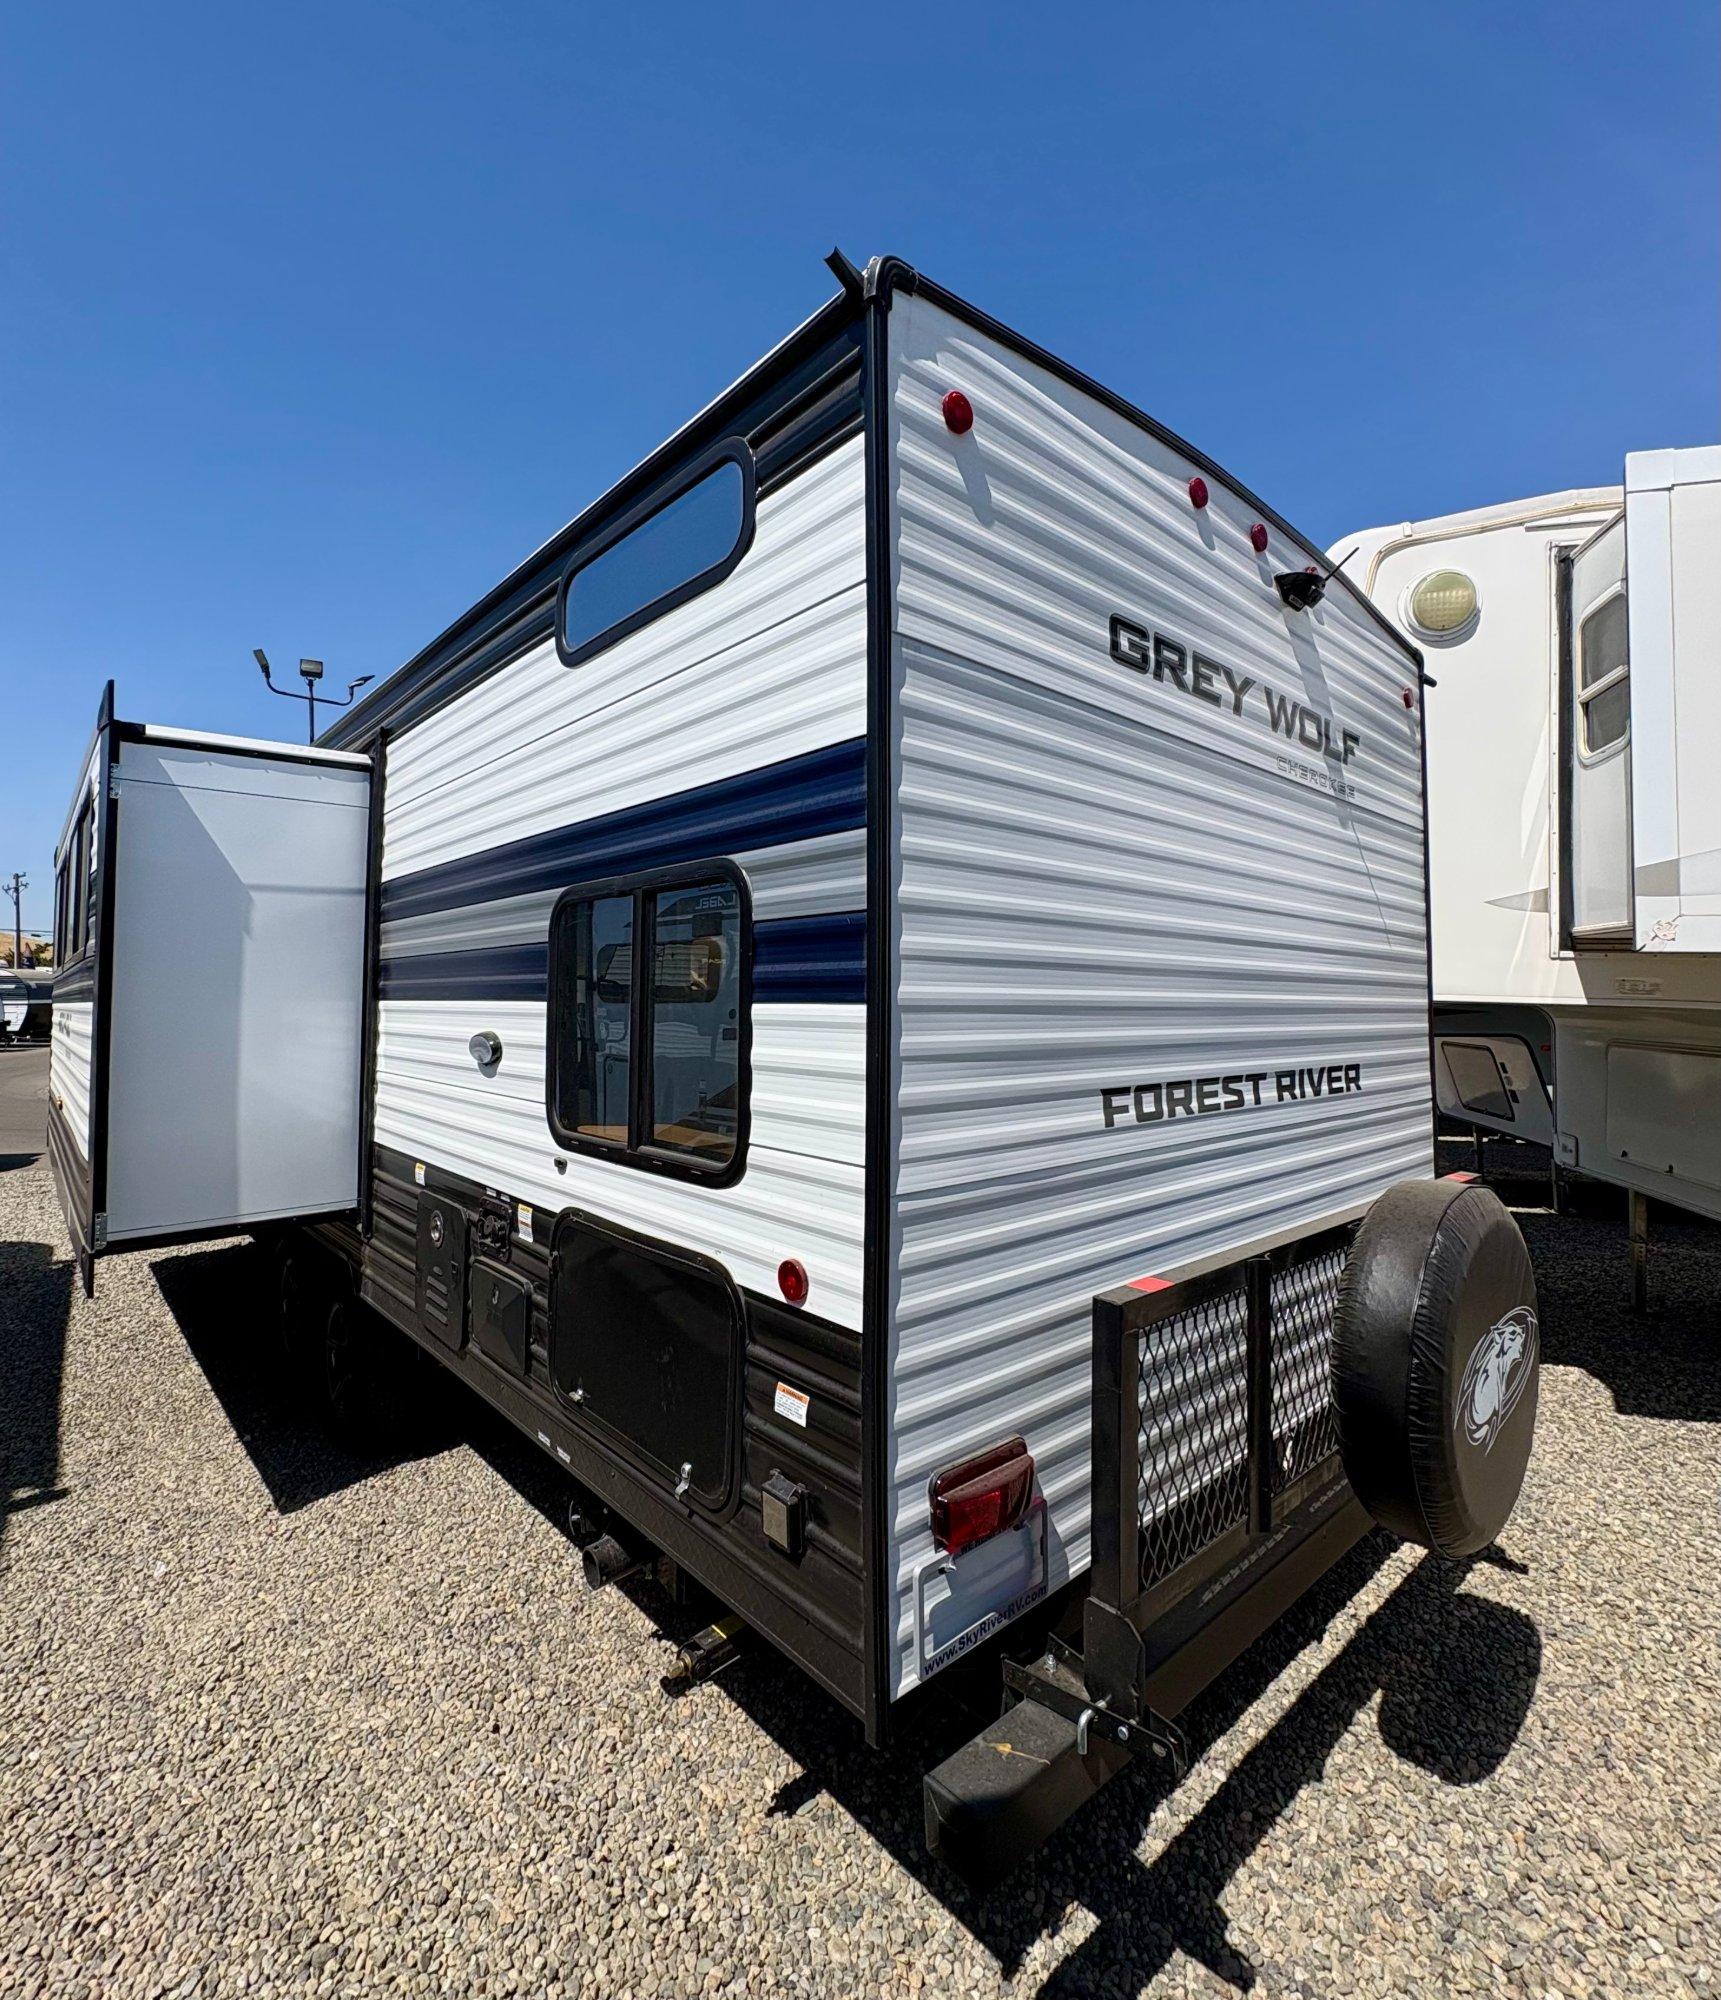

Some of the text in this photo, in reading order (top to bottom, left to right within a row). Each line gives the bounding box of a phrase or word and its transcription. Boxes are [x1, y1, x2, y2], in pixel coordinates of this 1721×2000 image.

[1109, 612, 1360, 765] GREY WOLF
[1100, 1063, 1362, 1128] FOREST RIVER
[924, 1585, 1048, 1676] www.SkyRiverRV.com
